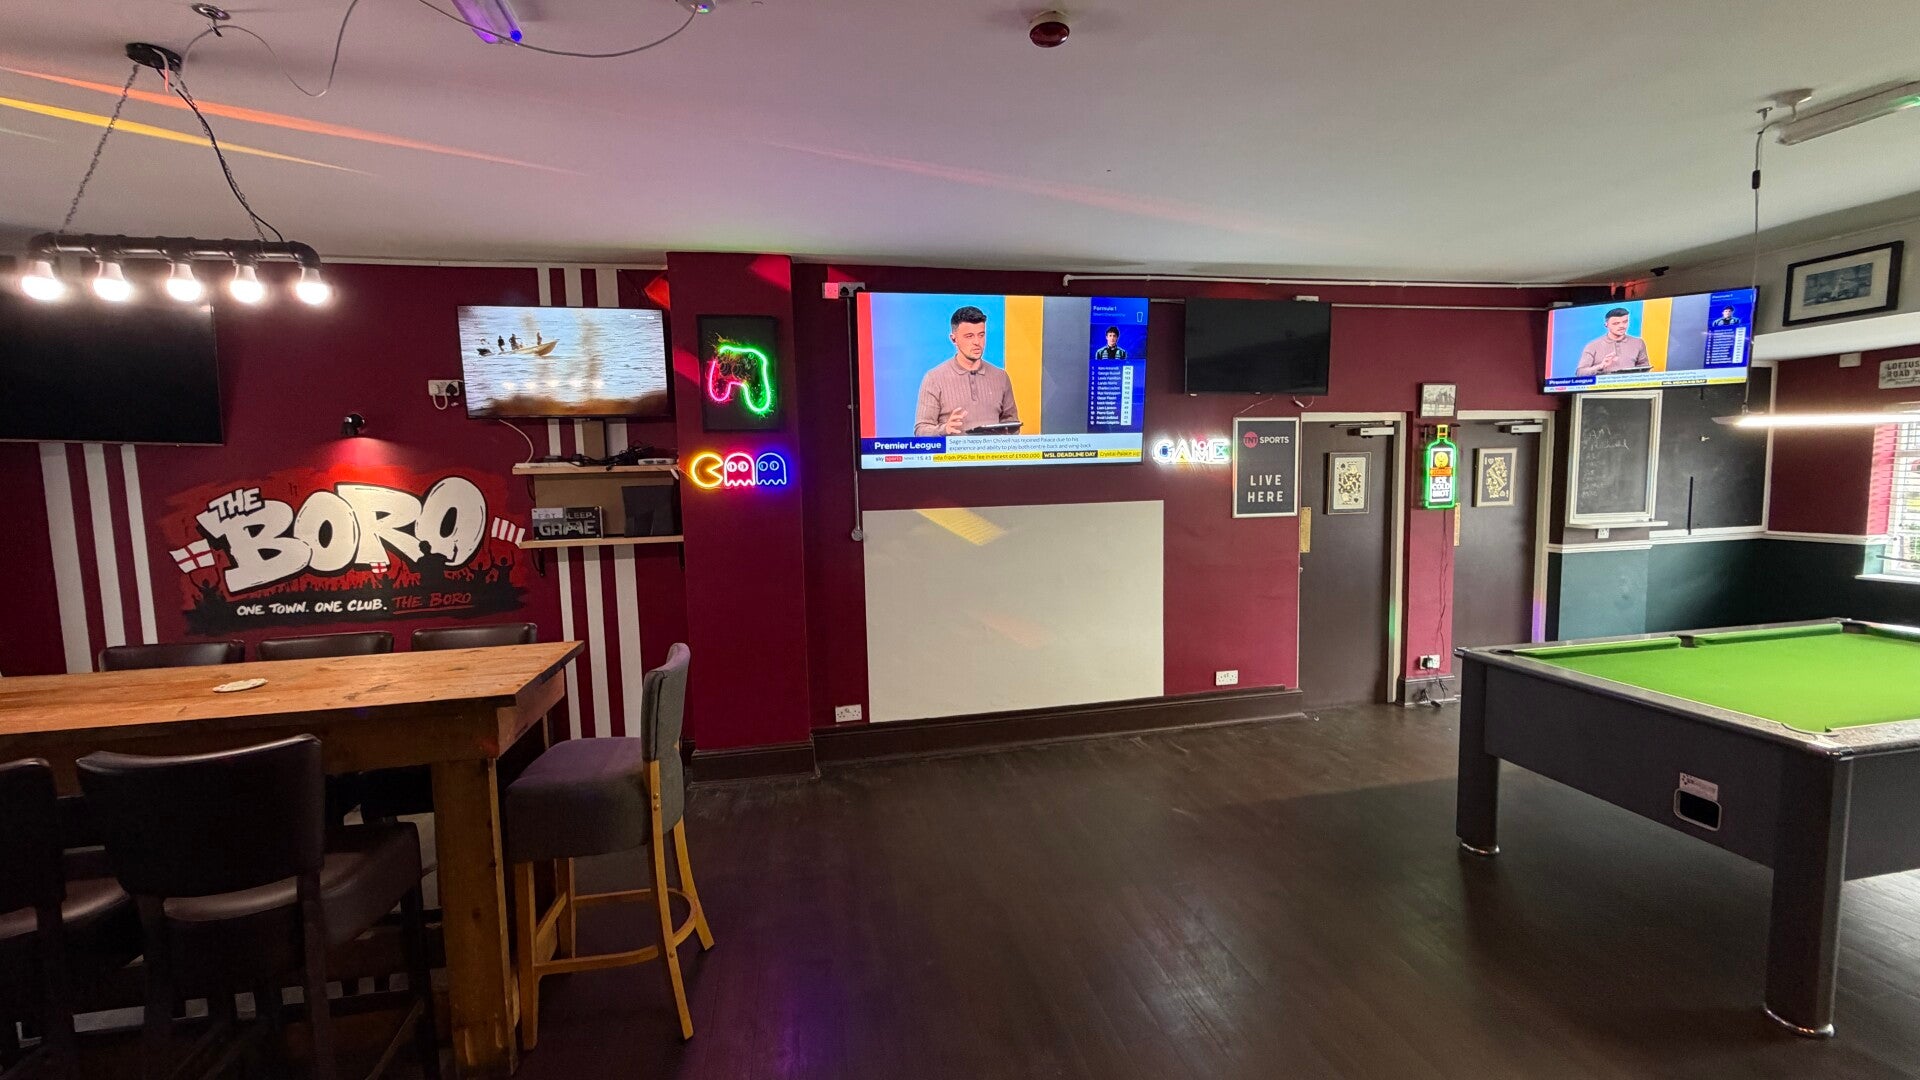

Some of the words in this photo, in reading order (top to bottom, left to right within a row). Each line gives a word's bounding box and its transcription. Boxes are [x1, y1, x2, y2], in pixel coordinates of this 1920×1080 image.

[1887, 360, 1920, 371] LOFTUS
[1886, 369, 1910, 378] ROAD
[967, 438, 982, 446] happy
[1259, 435, 1290, 444] SPORTS
[874, 441, 909, 450] Premier
[909, 441, 942, 451] League
[1153, 438, 1231, 464] GAME
[1250, 474, 1282, 486] LIVE
[1247, 490, 1284, 503] HERE
[207, 487, 267, 521] THE
[538, 519, 597, 536] GAME
[196, 476, 488, 594] BORO
[236, 603, 265, 616] ONE
[270, 602, 310, 615] TOWN.
[314, 600, 342, 613] ONE
[346, 598, 388, 612] CLUB.
[392, 595, 424, 609] THE
[428, 592, 473, 606] BORO
